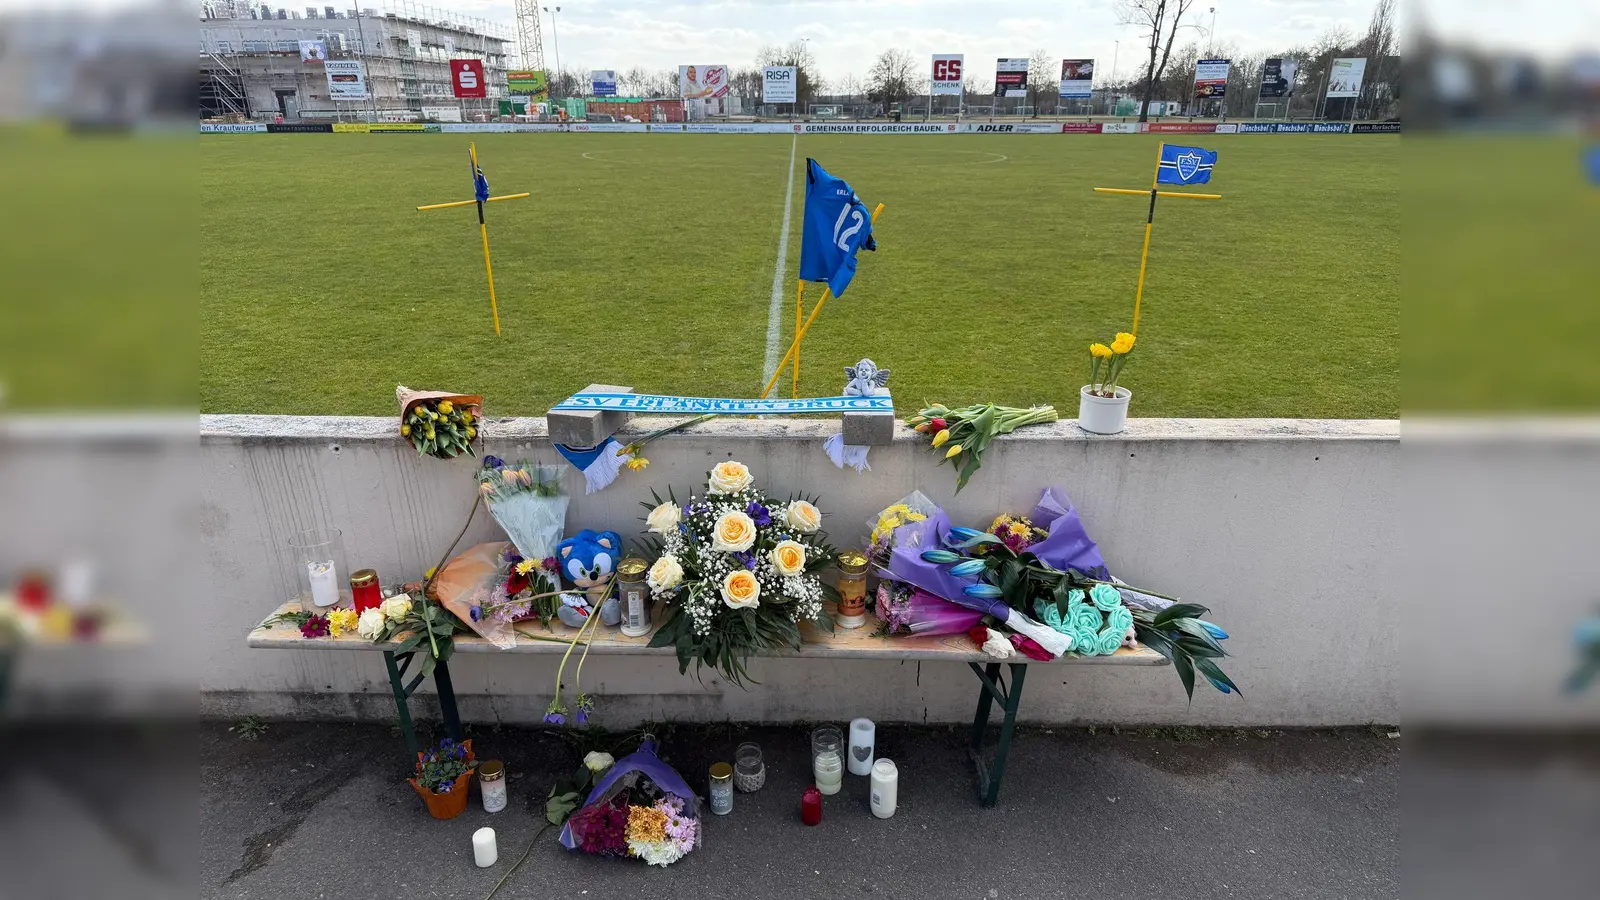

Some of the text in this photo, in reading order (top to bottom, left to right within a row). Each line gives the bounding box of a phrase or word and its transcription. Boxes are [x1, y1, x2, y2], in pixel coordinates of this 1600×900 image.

[766, 71, 790, 80] RISA
[933, 60, 961, 81] GS
[213, 124, 257, 132] Krautwurst
[833, 203, 864, 252] 12
